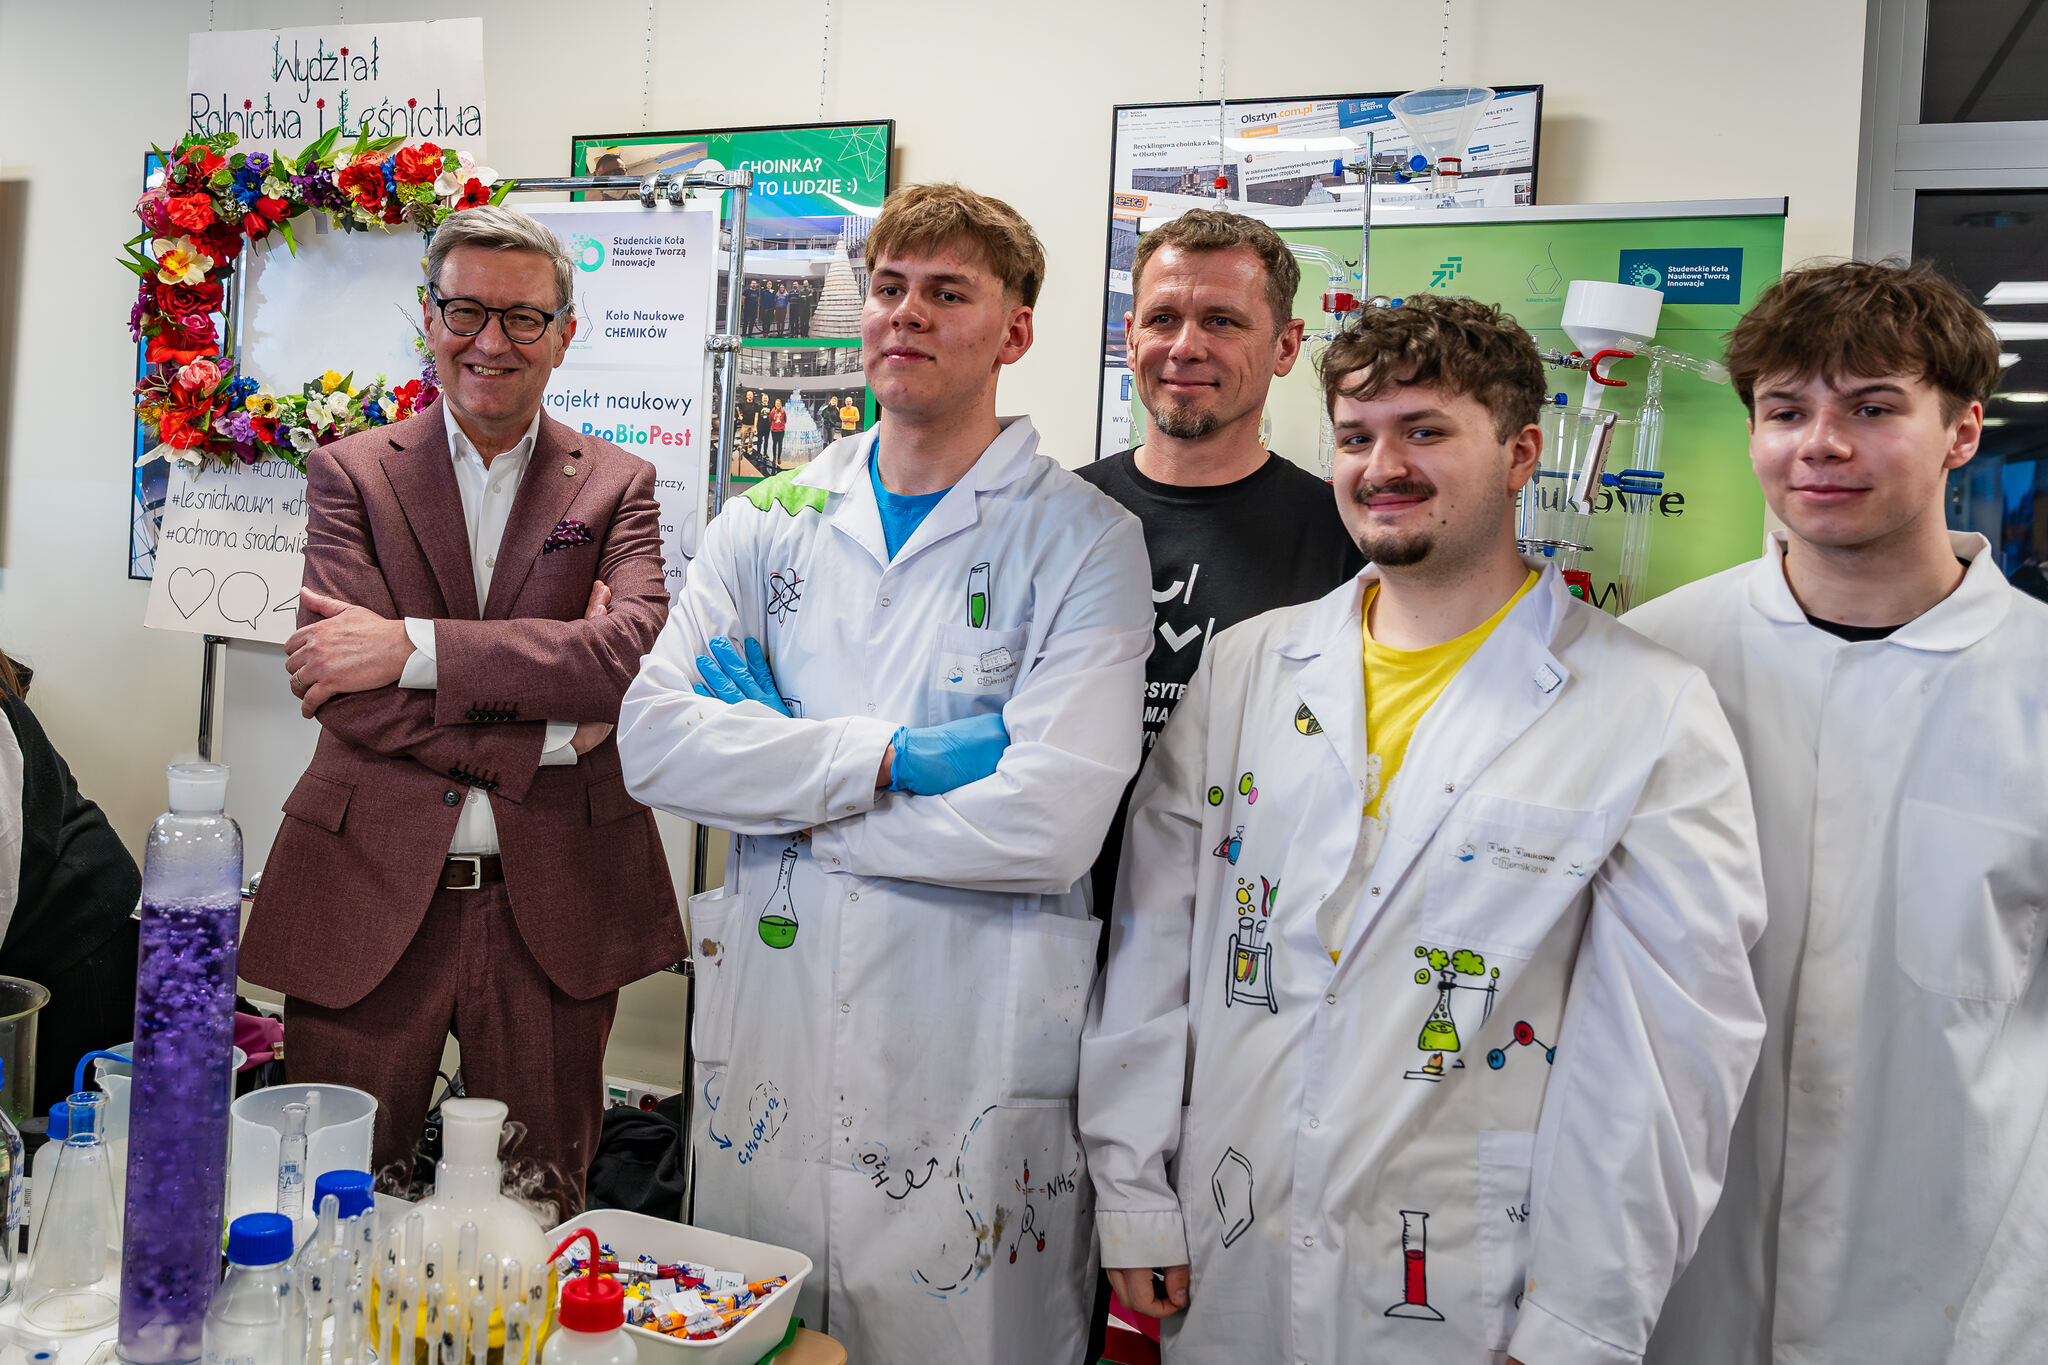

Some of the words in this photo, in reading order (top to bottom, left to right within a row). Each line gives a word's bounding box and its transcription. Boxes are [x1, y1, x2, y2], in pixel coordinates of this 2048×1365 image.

[271, 35, 379, 103] Wydział
[190, 92, 301, 139] Rolnictwa
[339, 88, 481, 138] Leśnictwa
[1241, 103, 1313, 124] Olsztyn.com.pl
[1176, 140, 1201, 148] choinka
[740, 157, 823, 175] CHOINKA?
[757, 181, 778, 196] TO
[783, 178, 842, 195] LUDZIE
[613, 236, 662, 245] Studenckie
[664, 236, 685, 245] Koła
[612, 247, 653, 256] Naukowe
[655, 247, 686, 257] Tworzą
[611, 258, 656, 268] Innowacje
[1667, 272, 1702, 280] Naukowe
[1667, 280, 1705, 288] Innowacje
[605, 310, 630, 321] Koło
[633, 310, 685, 321] Naukowe
[605, 326, 668, 338] CHEMIKÓW
[606, 391, 692, 416] naukowy
[582, 422, 691, 446] ProBioPest
[166, 519, 237, 549] #ochrona
